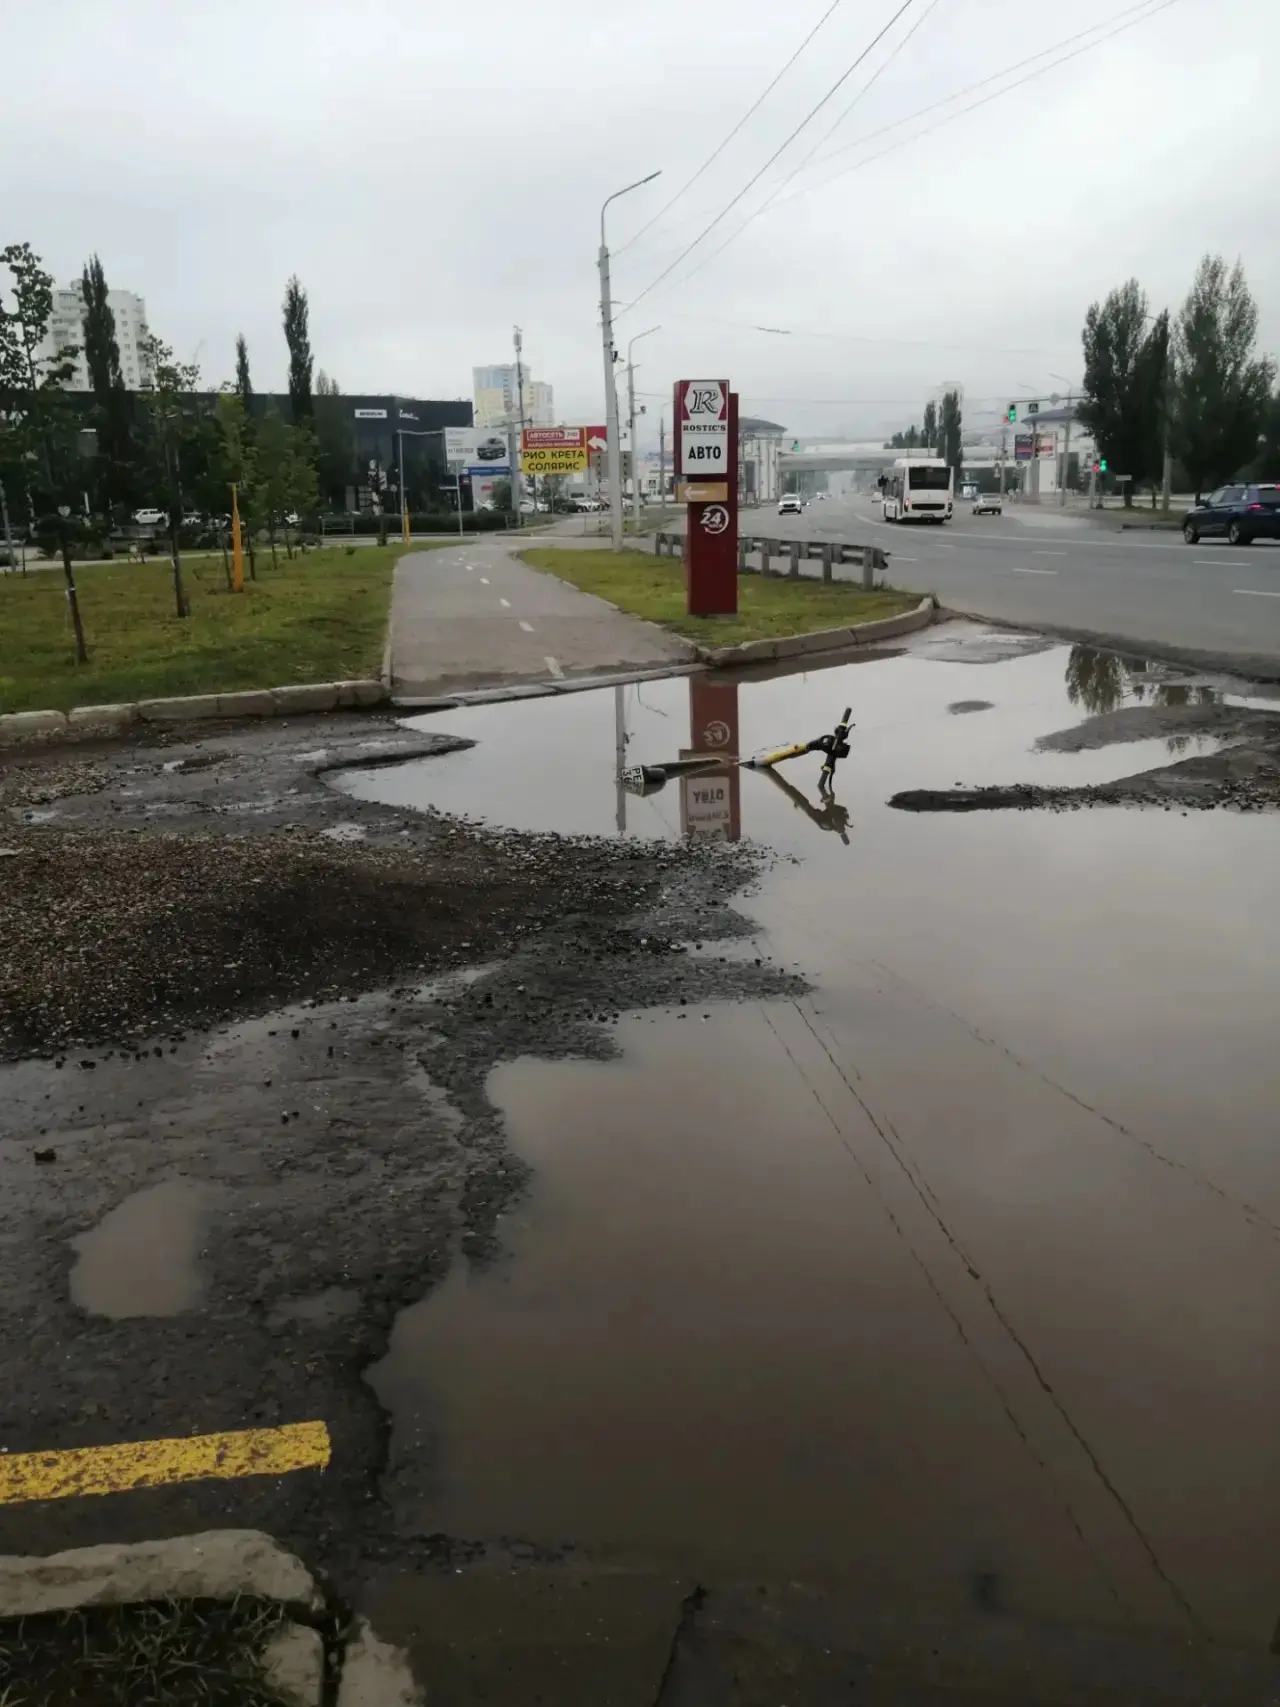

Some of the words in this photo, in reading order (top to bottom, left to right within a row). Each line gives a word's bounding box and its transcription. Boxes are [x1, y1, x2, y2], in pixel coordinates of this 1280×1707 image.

[682, 424, 726, 432] ROSTIC'S
[523, 451, 546, 460] РИО
[551, 450, 585, 459] КРЕТА
[687, 446, 722, 460] АВТО
[528, 461, 580, 471] СОЛЯРИС
[700, 512, 722, 525] 24
